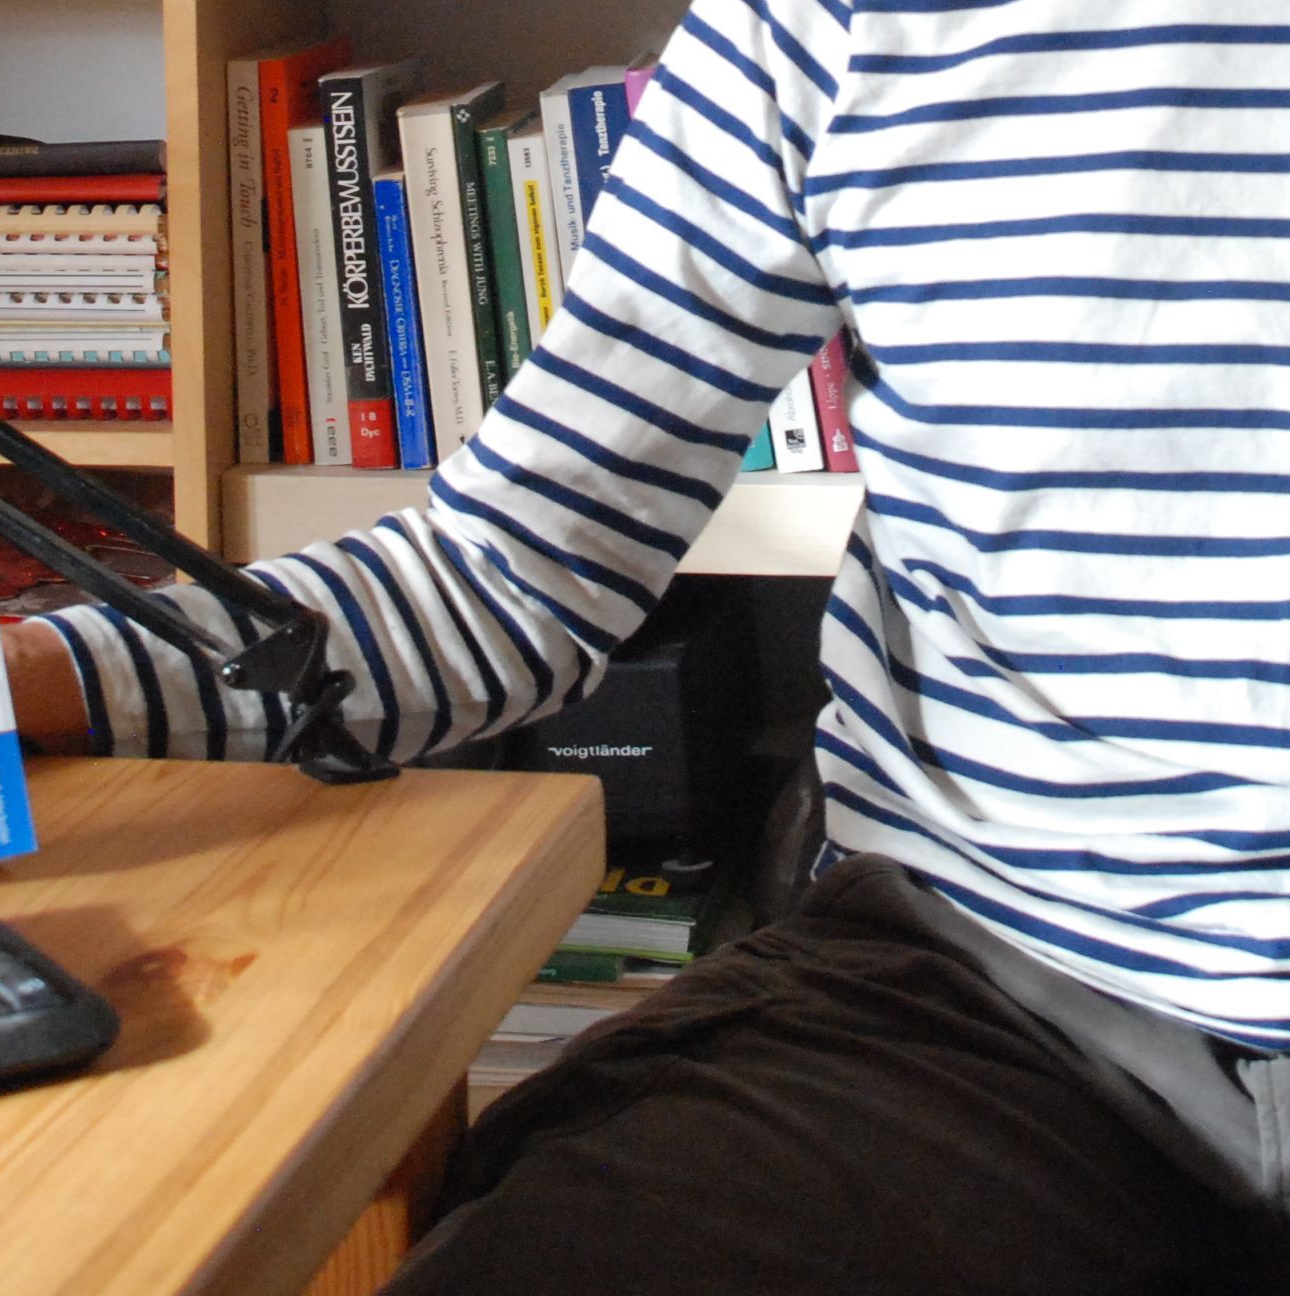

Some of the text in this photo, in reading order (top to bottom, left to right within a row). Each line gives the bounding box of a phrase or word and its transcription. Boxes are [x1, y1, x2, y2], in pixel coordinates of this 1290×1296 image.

[234, 86, 254, 148] Getting
[592, 90, 610, 156] Tanztherapie
[240, 153, 253, 172] in
[331, 91, 370, 308] KÖRPERBEWUSSTSEIN
[425, 147, 450, 276] Surviving Schizophrenia
[466, 181, 488, 305] MEETINGS WITH JUNG
[351, 343, 363, 363] KEN
[549, 745, 653, 759] voigtländer
